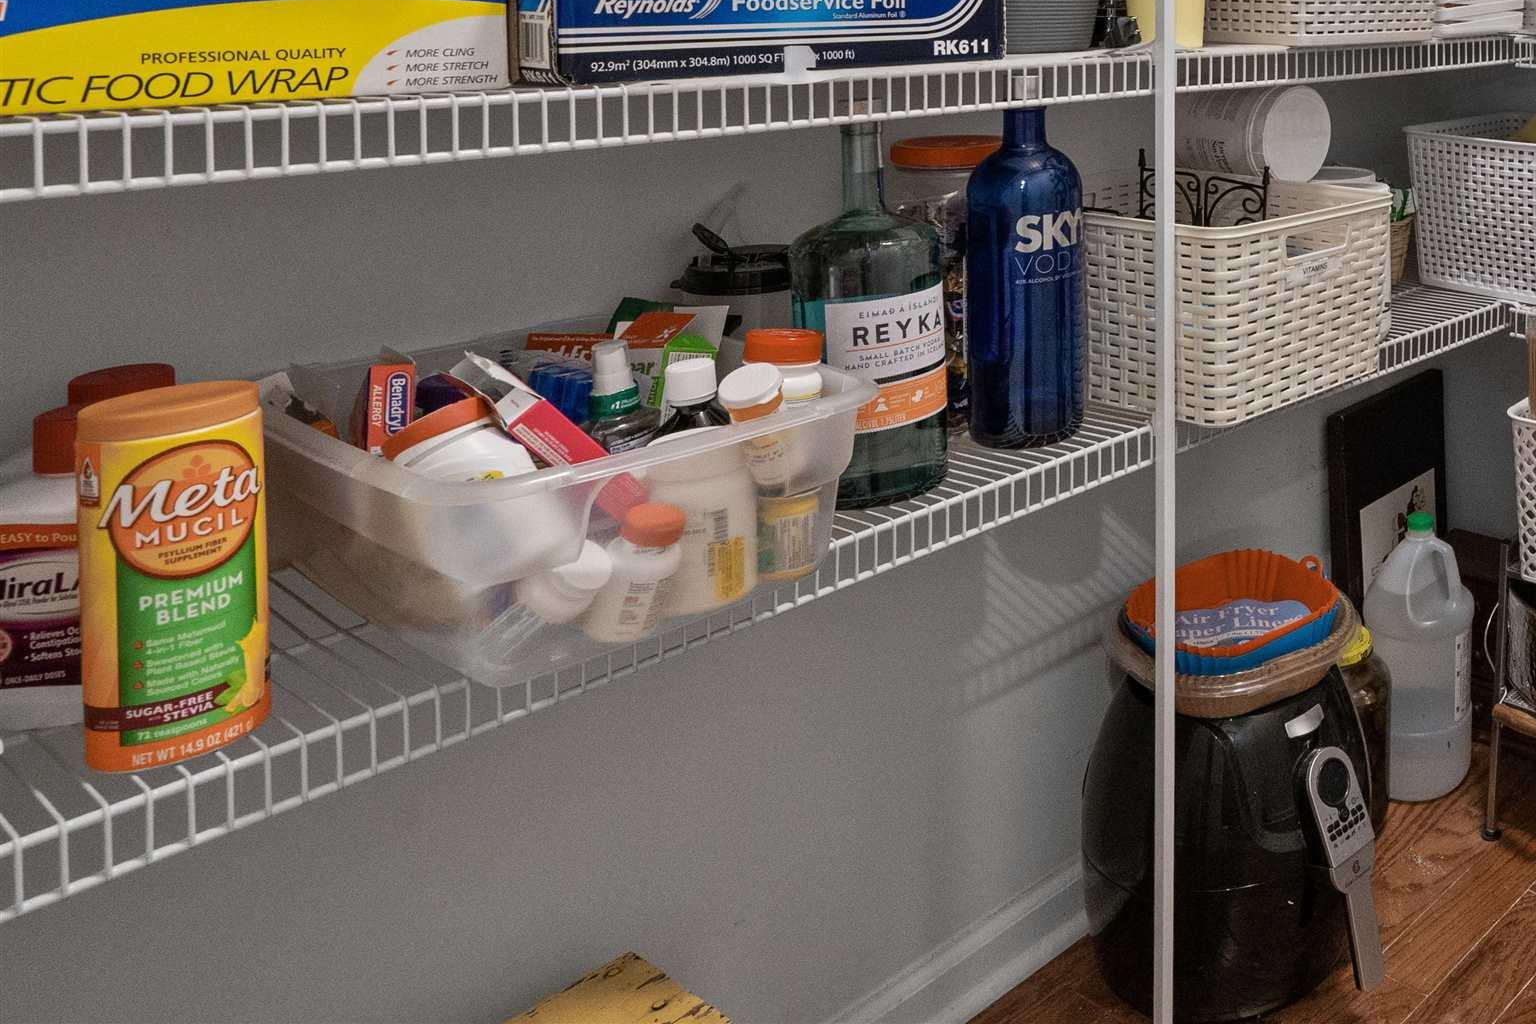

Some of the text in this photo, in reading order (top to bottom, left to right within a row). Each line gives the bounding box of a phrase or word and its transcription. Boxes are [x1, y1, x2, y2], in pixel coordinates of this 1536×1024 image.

[140, 47, 347, 65] PROFESSIONAL QUALITY
[405, 47, 476, 59] MORE CLING
[933, 38, 990, 56] RK611
[405, 61, 489, 73] MORE STRETCH
[590, 50, 844, 73] 92.9m² (304mm 304.8m) 1000 1000
[0, 66, 349, 107] TIC FOOD WRAP
[405, 75, 498, 87] MORE STRENGTH
[1302, 262, 1329, 276] VITAMINS
[852, 309, 942, 347] REYKA
[845, 354, 915, 371] HAND CRAFTED
[859, 344, 920, 362] SMALL BATCH
[372, 384, 384, 428] ALLERGY
[389, 378, 407, 432] Benadryl
[96, 463, 263, 530] Meta
[0, 532, 49, 544] EASY to
[135, 509, 245, 549] MUCIL
[158, 541, 204, 560] PSYLLIUM
[164, 546, 223, 566] SUPPLEMENT
[138, 571, 244, 611] PREMIUM
[156, 593, 232, 625] BLEND
[1175, 604, 1280, 626] Air Fryer
[29, 629, 65, 642] Relieves
[29, 650, 63, 663] Softens
[125, 690, 215, 720] SUGAR-FREE
[162, 701, 215, 724] STEVIA
[153, 718, 209, 739] teaspoons
[131, 745, 178, 766] NET WT
